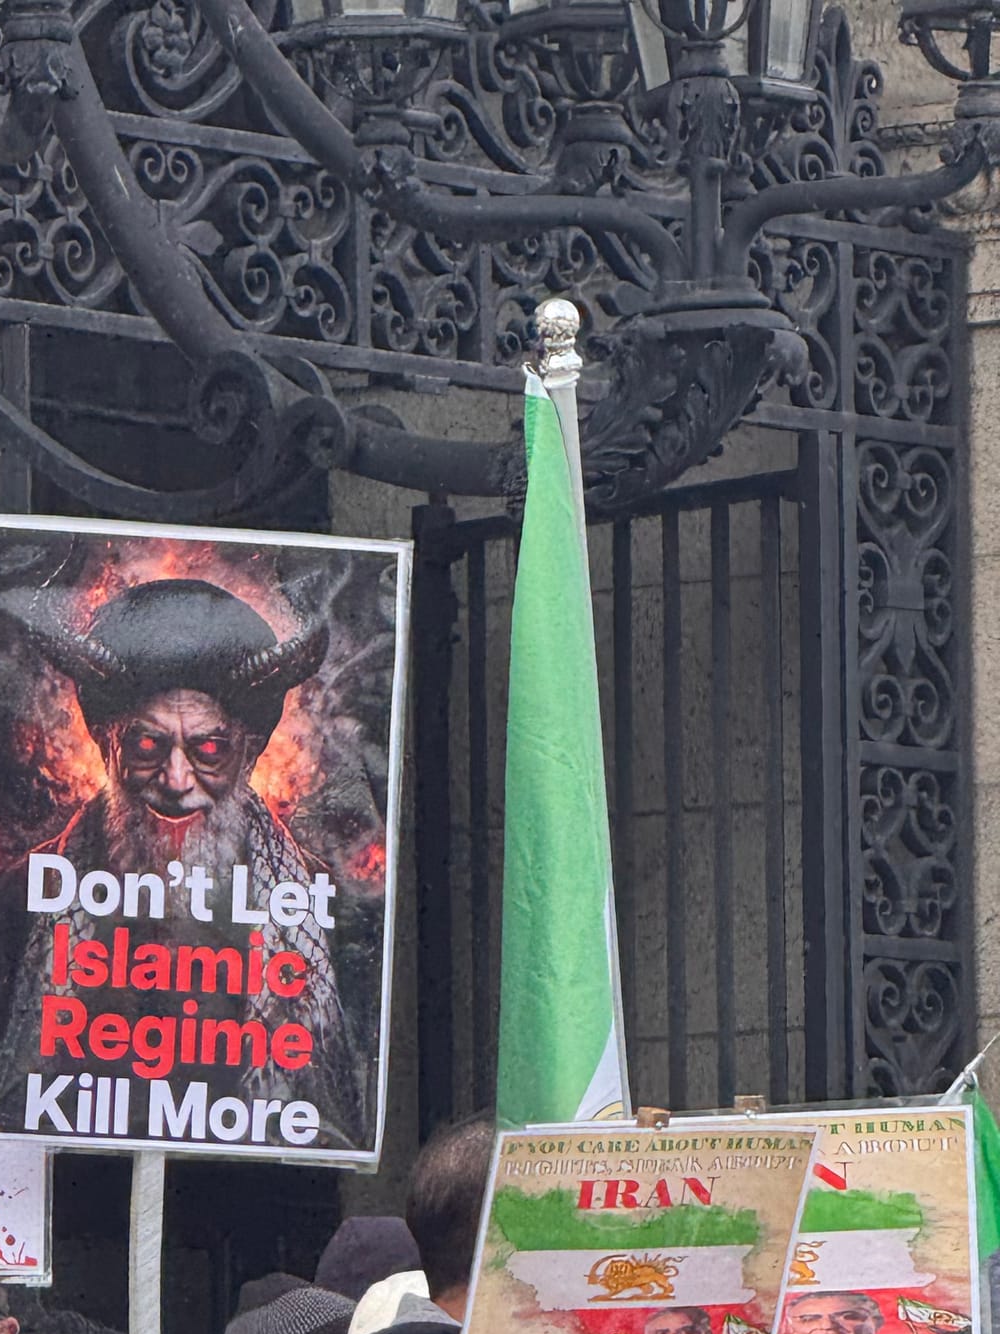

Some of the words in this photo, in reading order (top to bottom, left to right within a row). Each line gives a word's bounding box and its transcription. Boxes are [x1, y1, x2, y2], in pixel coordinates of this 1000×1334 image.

[27, 853, 214, 923] Don't
[232, 864, 337, 930] Let
[52, 922, 307, 998] Islamic
[40, 994, 313, 1080] Regime
[24, 1072, 130, 1135] Kill
[148, 1079, 320, 1145] More
[527, 1139, 573, 1155] YOU
[577, 1138, 640, 1154] CARE
[646, 1137, 722, 1153] ABOUT
[726, 1136, 814, 1151] HUMAN
[616, 1155, 703, 1174] SPEAK
[707, 1154, 803, 1172] ABOUT
[833, 1136, 959, 1155] ABOUT
[577, 1175, 721, 1210] IRAN
